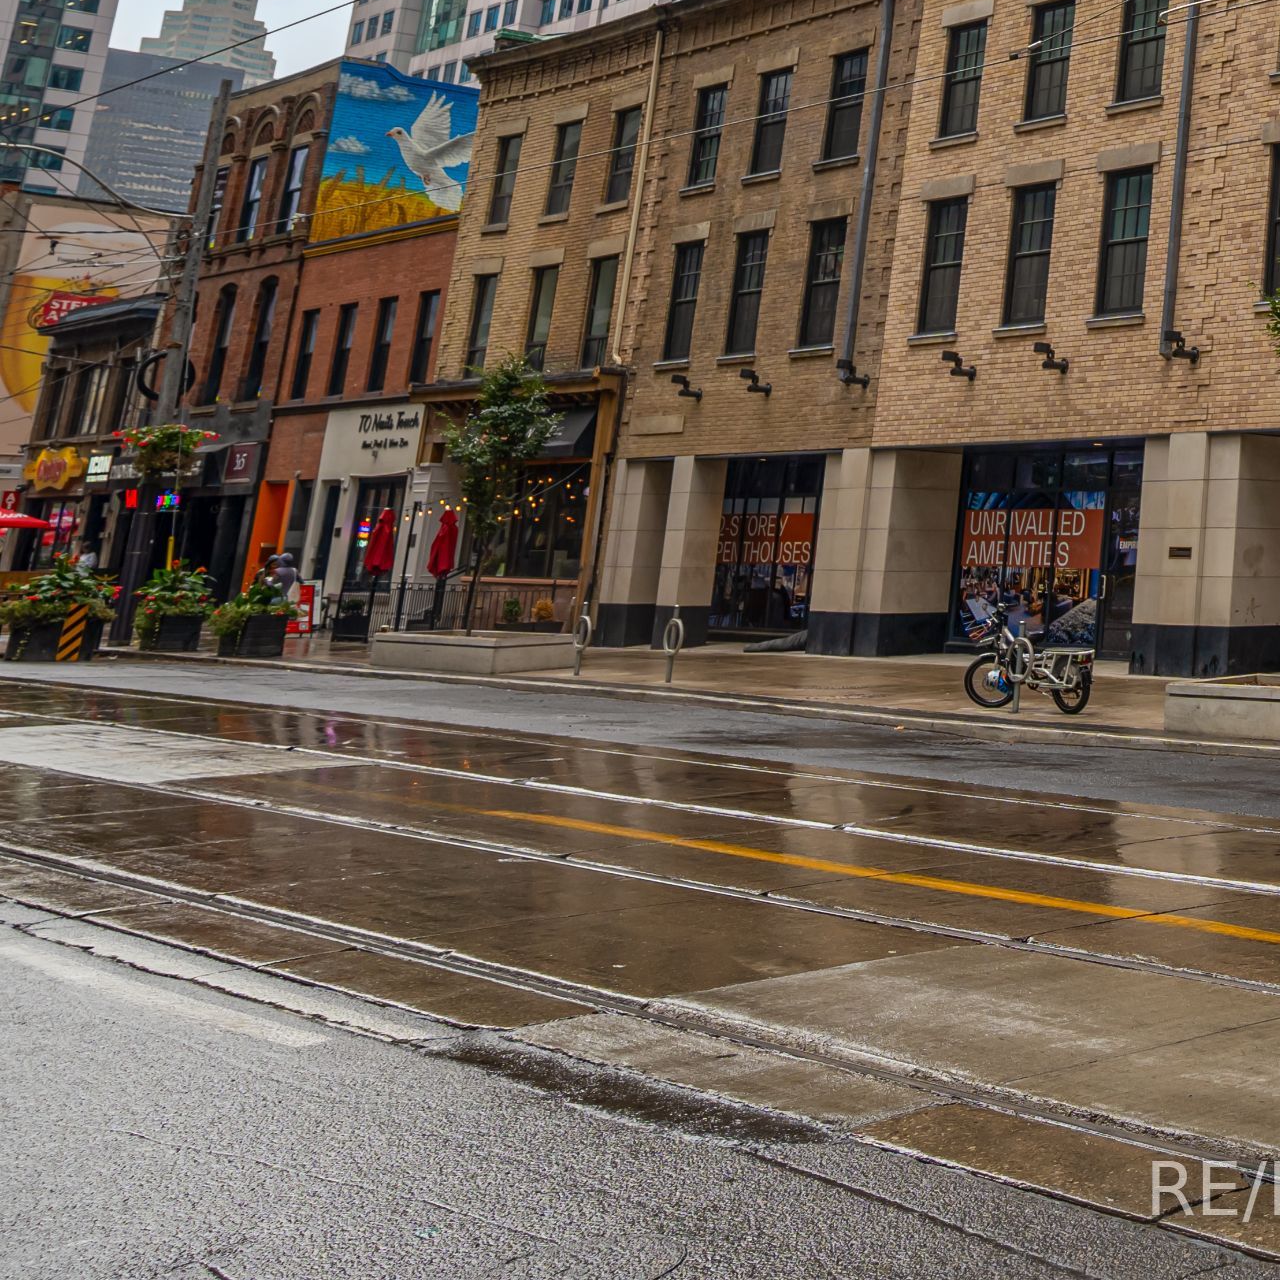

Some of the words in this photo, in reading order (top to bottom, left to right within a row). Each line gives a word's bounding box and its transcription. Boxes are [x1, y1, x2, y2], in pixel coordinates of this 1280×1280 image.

[359, 414, 372, 433] TO
[970, 511, 1086, 536] UNRIVALLED
[965, 540, 1070, 567] AMENITIES
